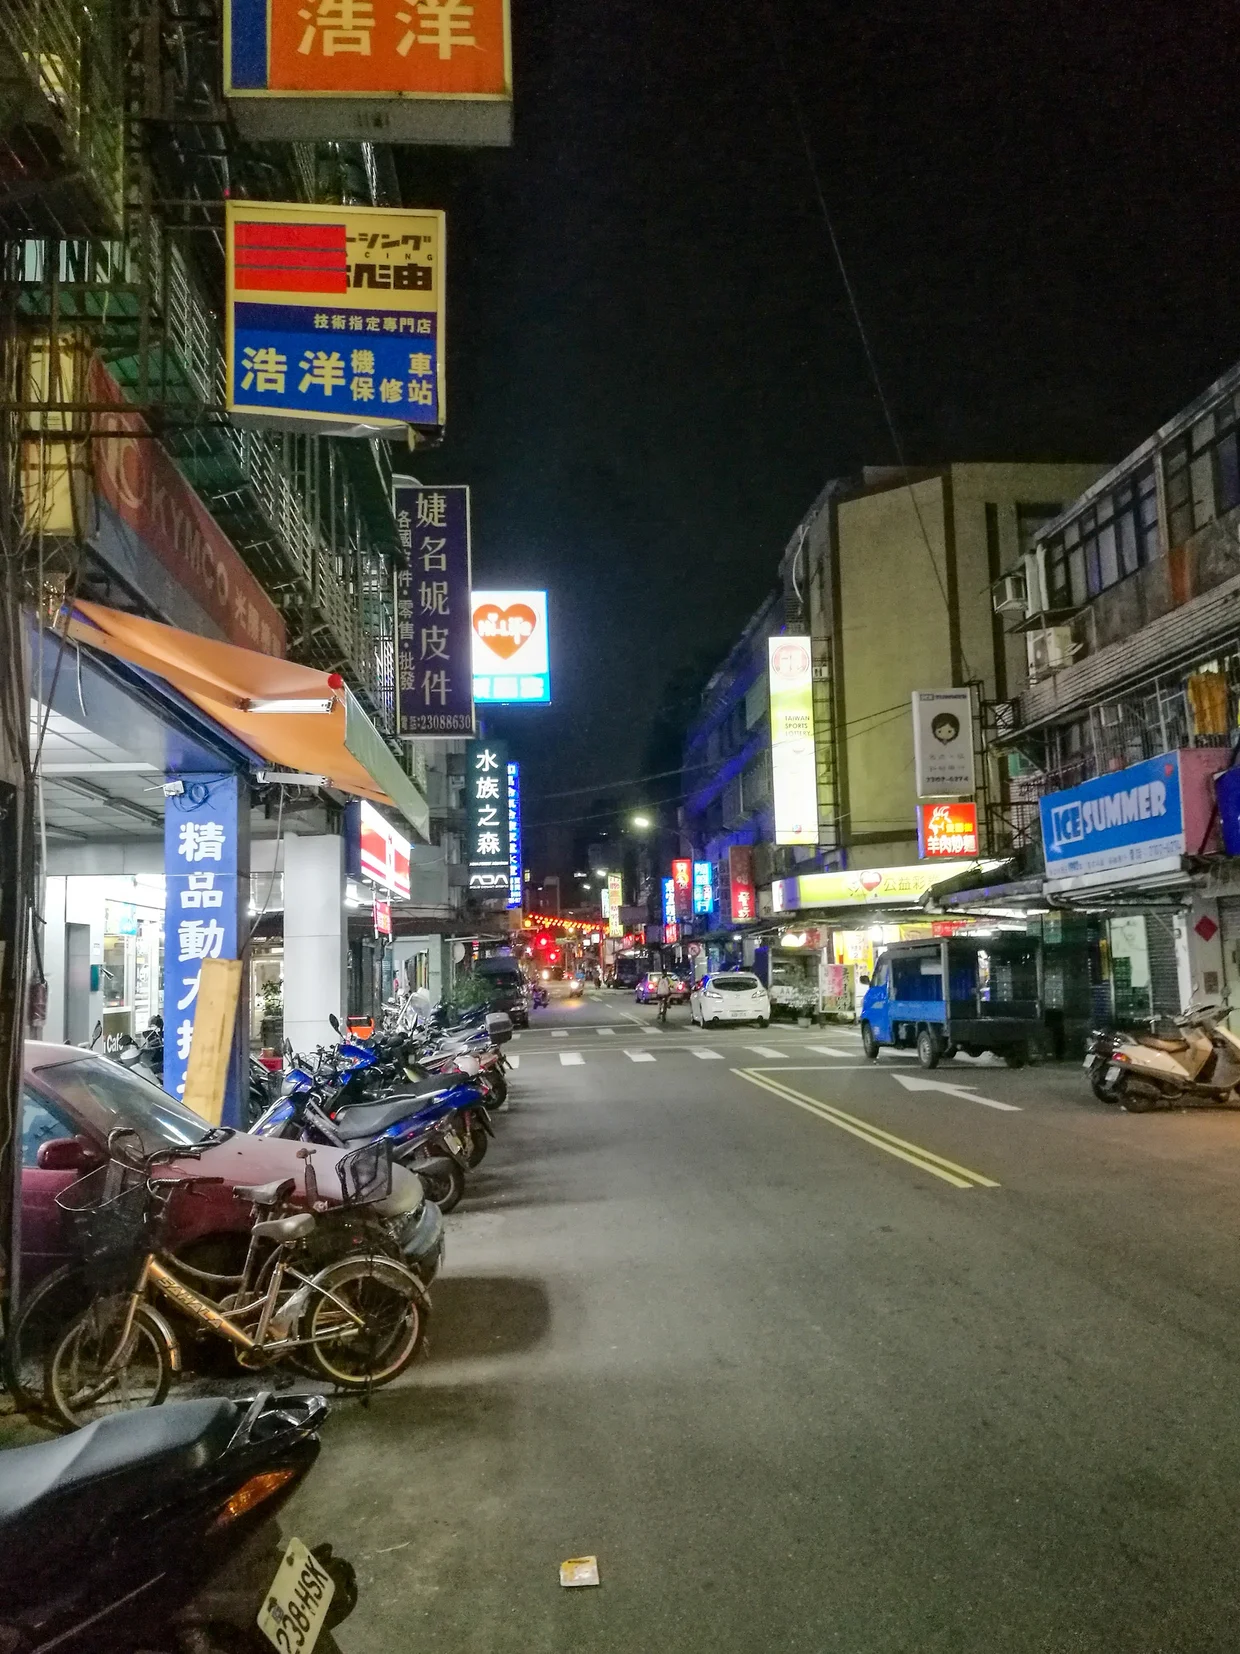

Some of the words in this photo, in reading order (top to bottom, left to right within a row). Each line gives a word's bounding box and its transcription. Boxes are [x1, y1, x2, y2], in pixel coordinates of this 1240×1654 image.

[297, 0, 476, 60] 浩洋
[346, 251, 433, 261] CING
[313, 313, 432, 334] 技術指定專門店
[240, 346, 346, 396] 浩洋
[415, 492, 452, 707] 婕名妮皮件
[475, 749, 501, 855] 水族之森
[1054, 808, 1081, 843] ICE
[1082, 780, 1167, 835] SUMMER
